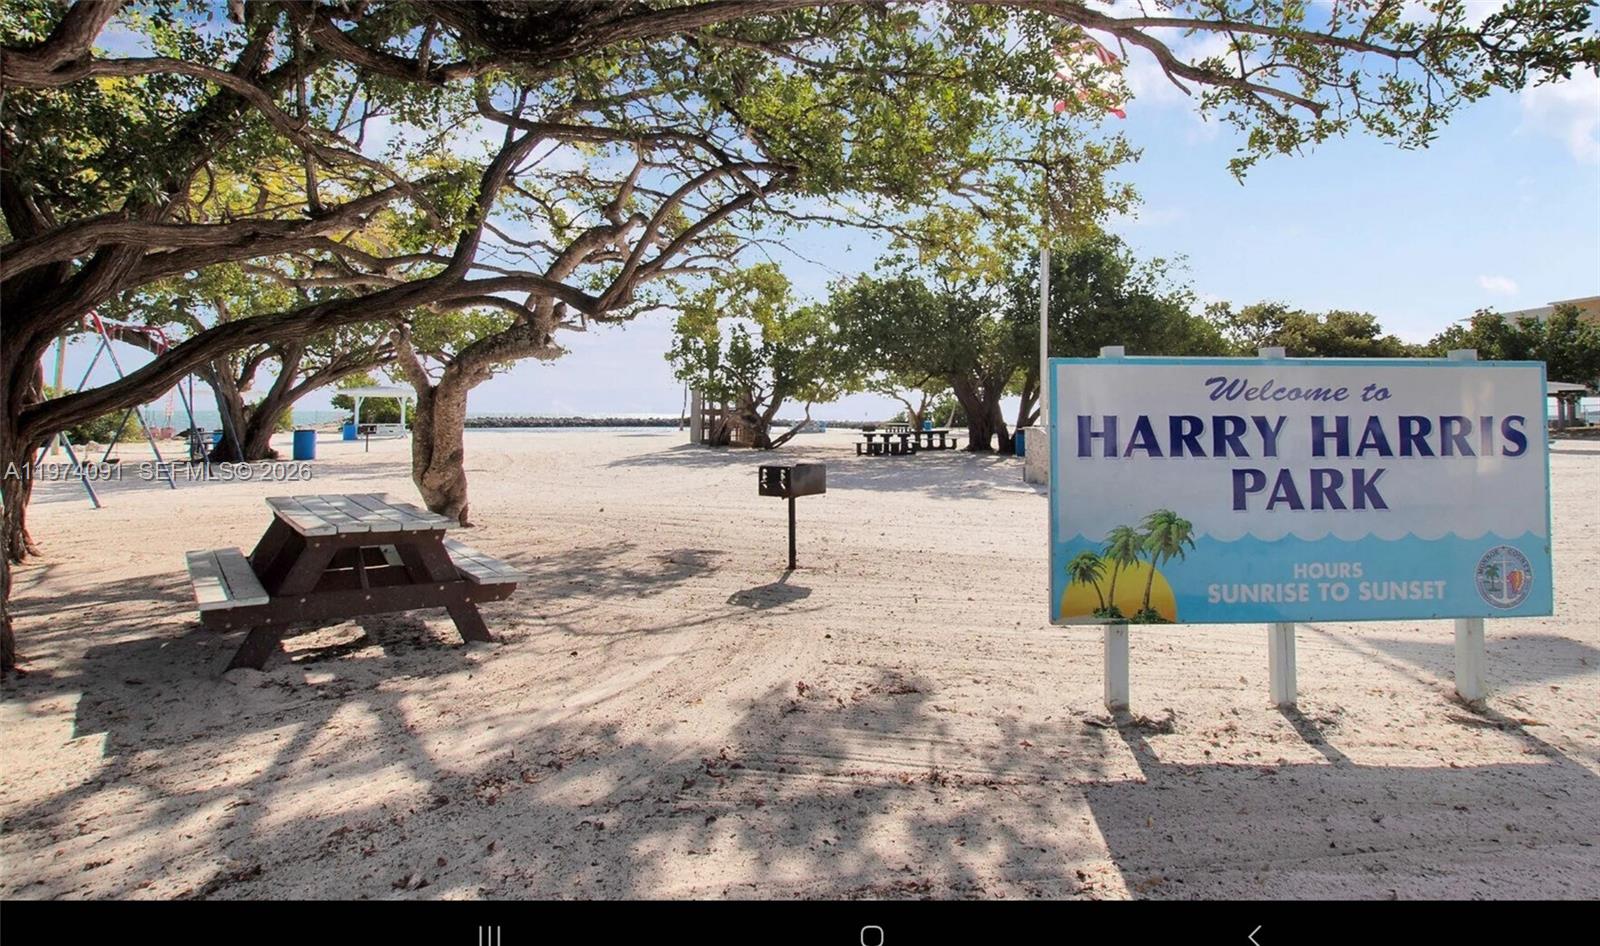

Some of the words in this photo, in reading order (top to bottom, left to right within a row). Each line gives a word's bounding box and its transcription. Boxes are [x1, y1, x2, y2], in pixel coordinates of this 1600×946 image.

[1205, 377, 1350, 402] Welcome
[1360, 379, 1391, 402] to
[1075, 415, 1287, 458] HARRY
[1311, 415, 1528, 458] HARRIS
[1232, 468, 1390, 511] PARK
[1293, 563, 1363, 579] HOURS
[1207, 582, 1310, 604] SUNRISE
[1318, 582, 1349, 602] TO
[1358, 580, 1446, 601] SUNSET
